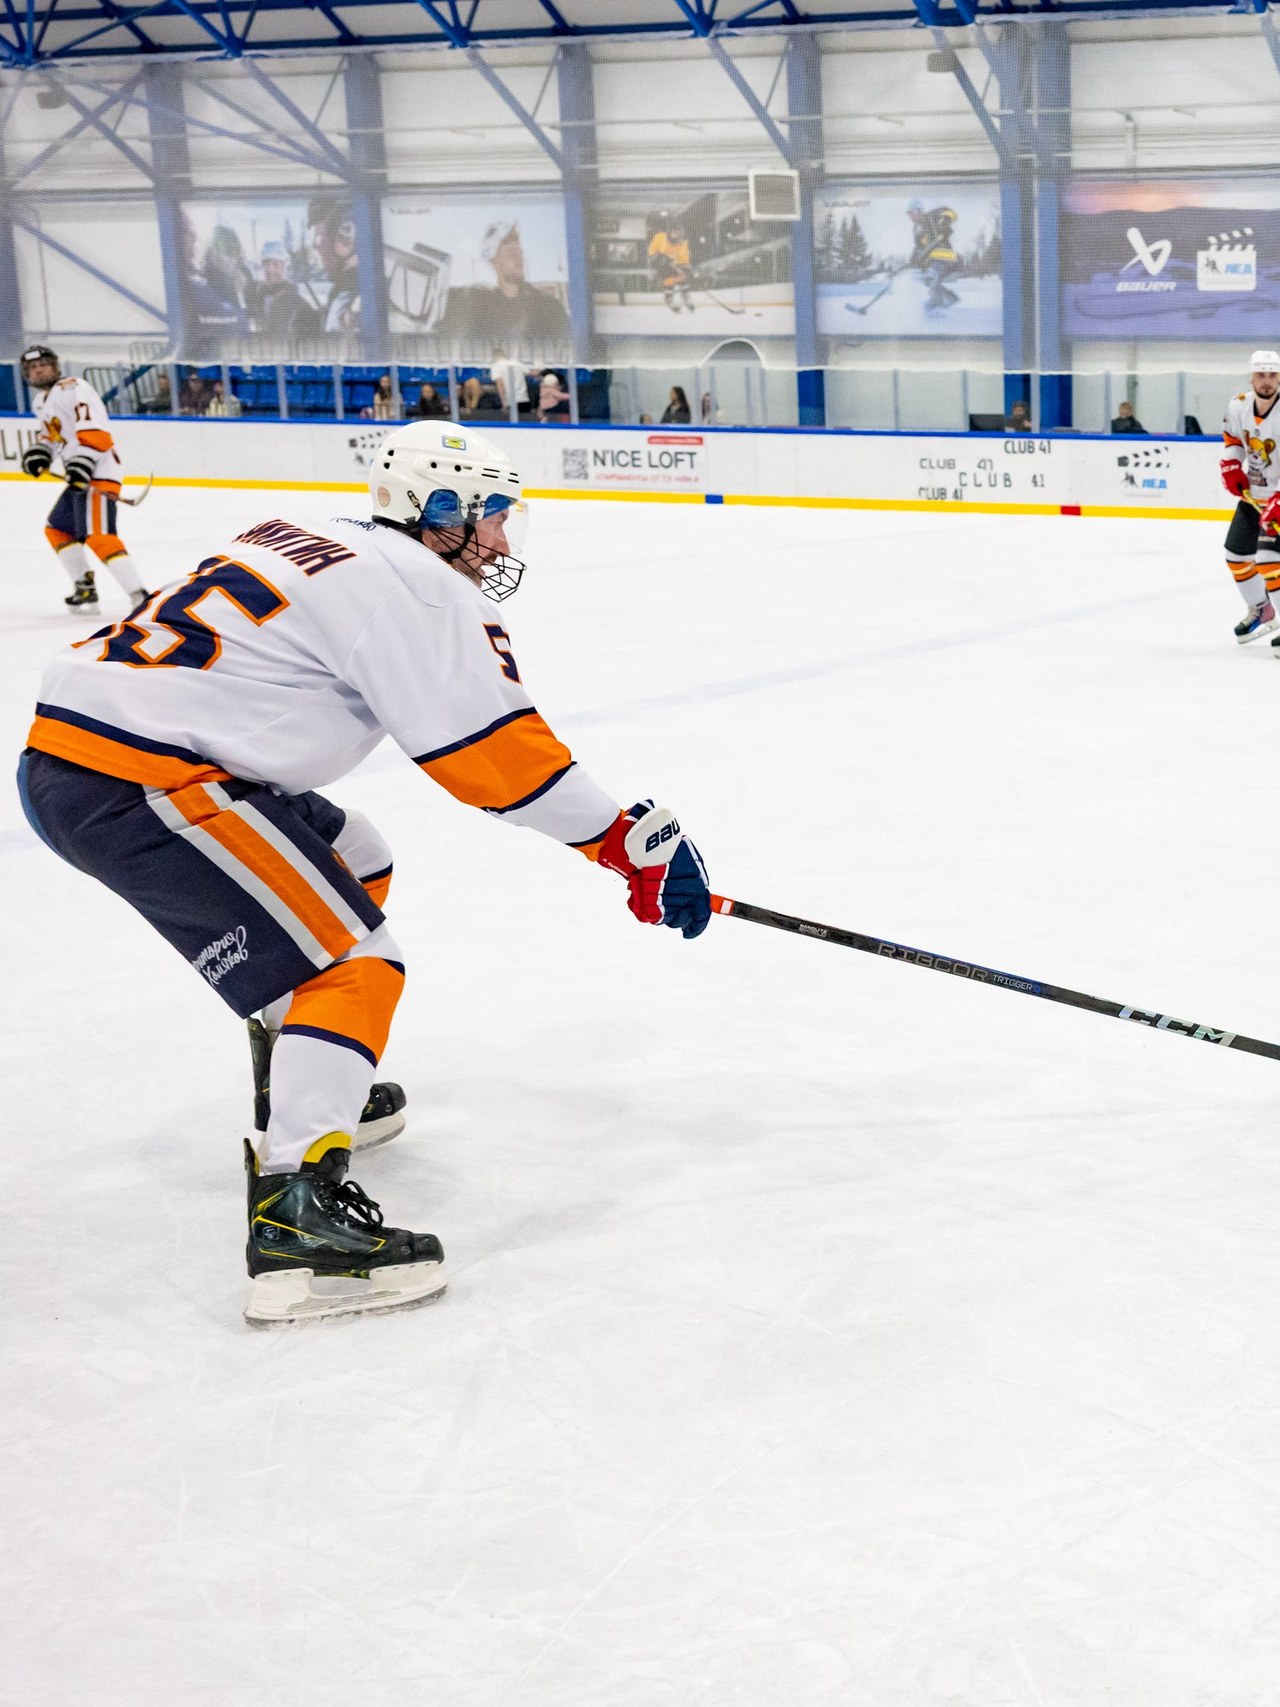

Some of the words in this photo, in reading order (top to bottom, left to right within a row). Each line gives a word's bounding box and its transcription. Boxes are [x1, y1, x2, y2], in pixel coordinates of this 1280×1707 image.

[1004, 440, 1035, 454] CLUB
[1039, 441, 1052, 454] 41
[648, 451, 697, 469] LOFT
[920, 458, 956, 470] CLUB
[959, 472, 1012, 488] CLUB
[1031, 474, 1045, 487] 41
[877, 942, 989, 982] RIBCOR
[1118, 1004, 1237, 1047] CCM
